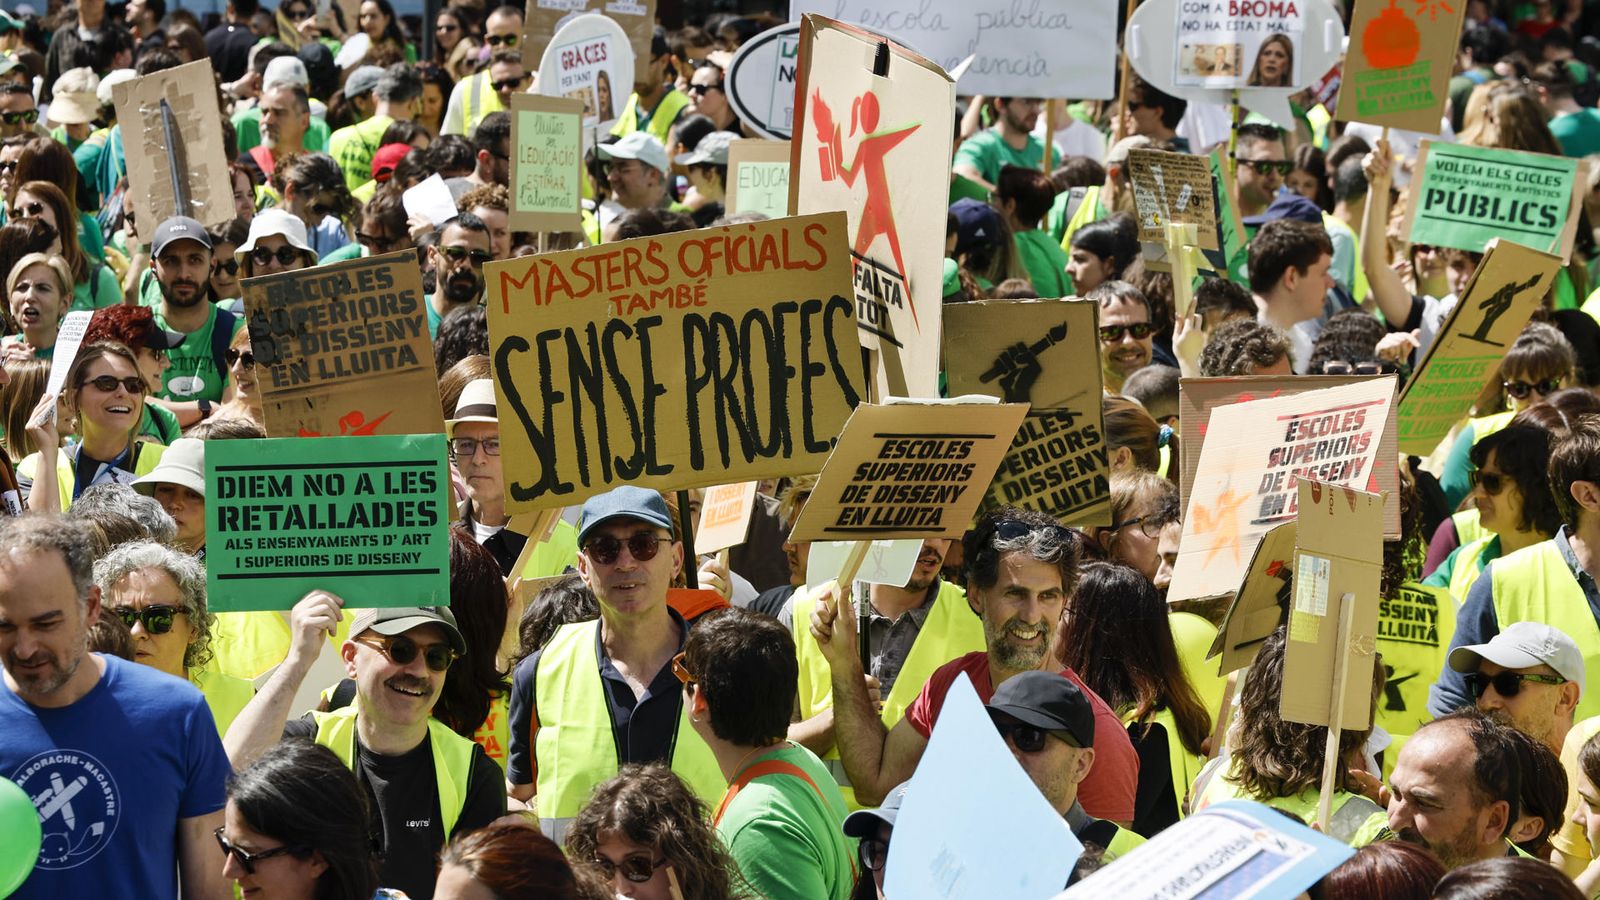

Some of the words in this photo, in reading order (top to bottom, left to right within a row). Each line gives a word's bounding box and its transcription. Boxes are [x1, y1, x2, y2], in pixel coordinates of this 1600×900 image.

[860, 3, 950, 31] escola
[973, 0, 1073, 45] pública
[1183, 2, 1209, 14] COM
[1215, 3, 1222, 13] A
[1229, 0, 1298, 18] BROMA
[1182, 20, 1200, 31] NO
[1204, 21, 1221, 31] HA
[1227, 21, 1261, 32] ESTAT
[1267, 21, 1290, 33] MAL
[561, 42, 607, 71] GRÀCIES
[1436, 160, 1484, 176] VOLEM
[1487, 167, 1511, 180] ELS
[1515, 171, 1562, 187] CICLES
[1424, 186, 1558, 229] PÚBLICS
[499, 239, 671, 314] MÀSTERS
[677, 223, 828, 279] OFICIALS
[609, 278, 708, 316] TAMBÉ
[854, 263, 903, 310] FALTA
[856, 293, 889, 330] TOT
[301, 314, 424, 357] DISSENY
[271, 359, 311, 388] EN
[317, 343, 419, 381] LLUITA
[495, 314, 674, 502] SENSE
[1285, 408, 1367, 442] ESCOLES
[878, 440, 975, 459] ESCOLES
[1267, 432, 1373, 468] SUPERIORS
[217, 475, 293, 499] DIEM
[303, 473, 345, 497] NO
[354, 472, 375, 495] A
[384, 471, 437, 495] LES
[852, 462, 976, 482] SUPERIORS
[1258, 470, 1286, 495] DE
[838, 485, 873, 504] DE
[871, 485, 968, 504] DISSENY
[1259, 492, 1288, 518] EN
[218, 500, 438, 532] RETALLADES
[835, 507, 871, 526] EN
[869, 507, 944, 526] LLUITA
[225, 538, 253, 550] ALS
[257, 535, 379, 550] ENSENYAMENTS
[402, 533, 432, 546] ART
[235, 556, 241, 568] I
[244, 554, 330, 568] SUPERIORS
[334, 553, 353, 566] DE
[358, 552, 422, 565] DISSENY
